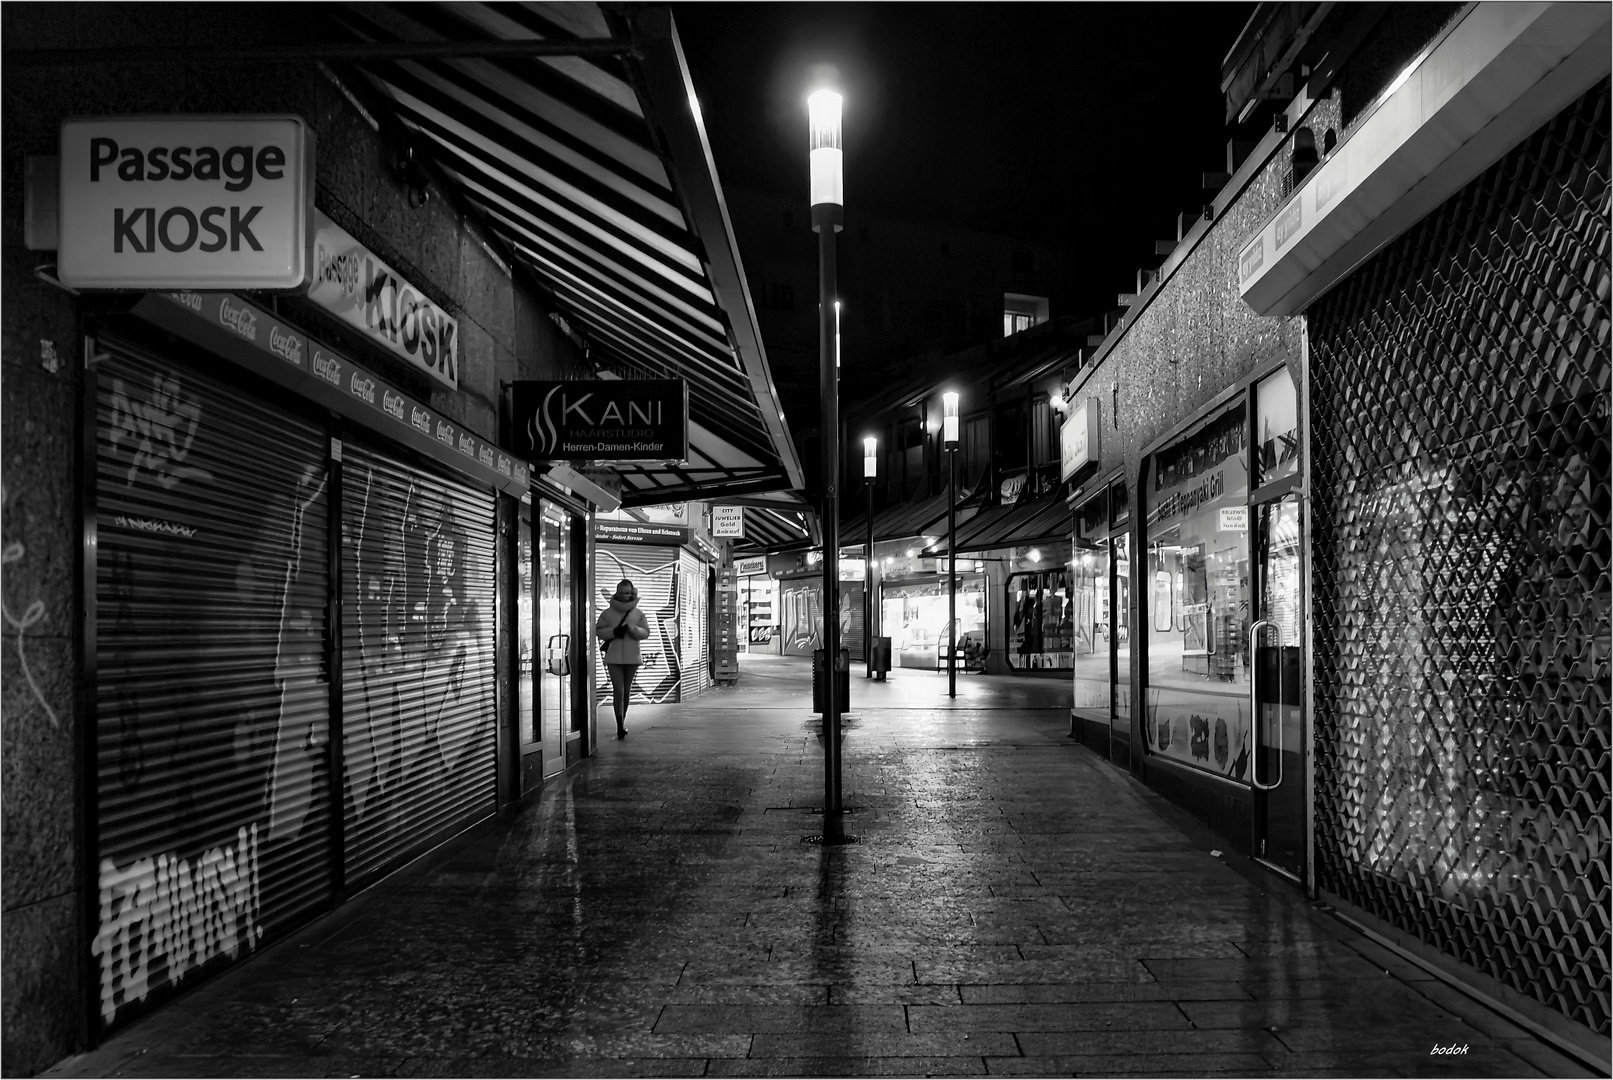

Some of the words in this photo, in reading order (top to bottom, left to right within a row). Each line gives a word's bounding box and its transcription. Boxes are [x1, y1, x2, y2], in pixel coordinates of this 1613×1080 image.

[89, 137, 286, 191] Passage
[113, 206, 264, 254] KIOSK
[318, 245, 359, 293] Passage
[365, 258, 455, 381] KIOSK
[562, 392, 662, 426] KANI
[570, 428, 654, 439] HAARSTUDIO
[1210, 469, 1224, 498] Grill
[661, 528, 681, 536] Schmuck
